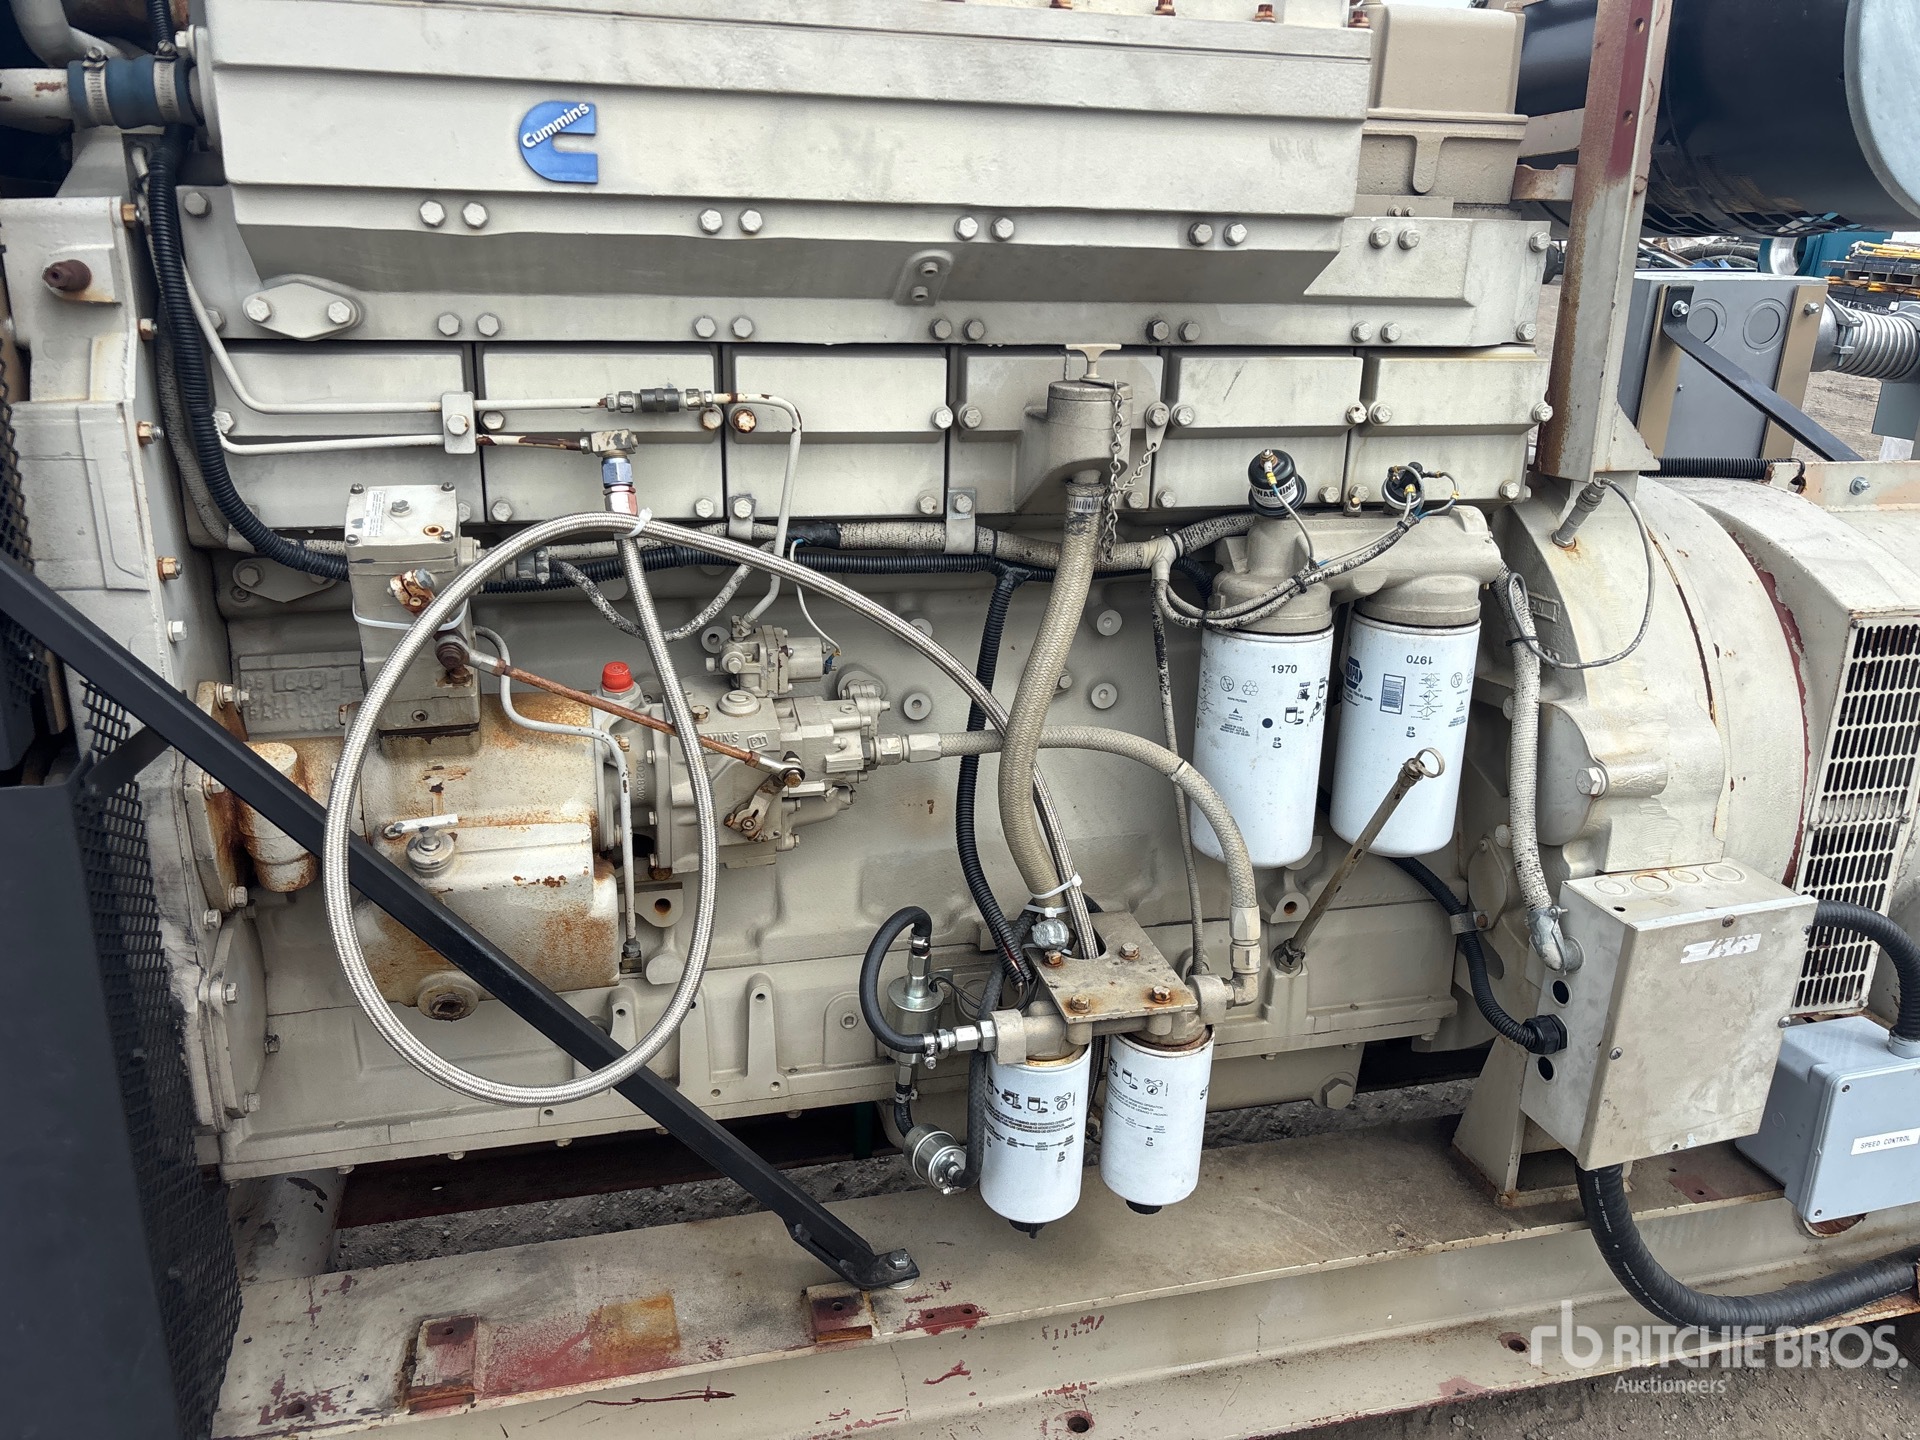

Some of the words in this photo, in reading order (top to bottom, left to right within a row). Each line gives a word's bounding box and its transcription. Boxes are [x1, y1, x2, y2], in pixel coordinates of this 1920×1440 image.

[522, 103, 590, 148] Cummins
[1406, 654, 1433, 665] 1970
[1271, 664, 1298, 674] 1970
[1860, 1140, 1881, 1149] SPEED
[1883, 1135, 1910, 1145] CONTROL
